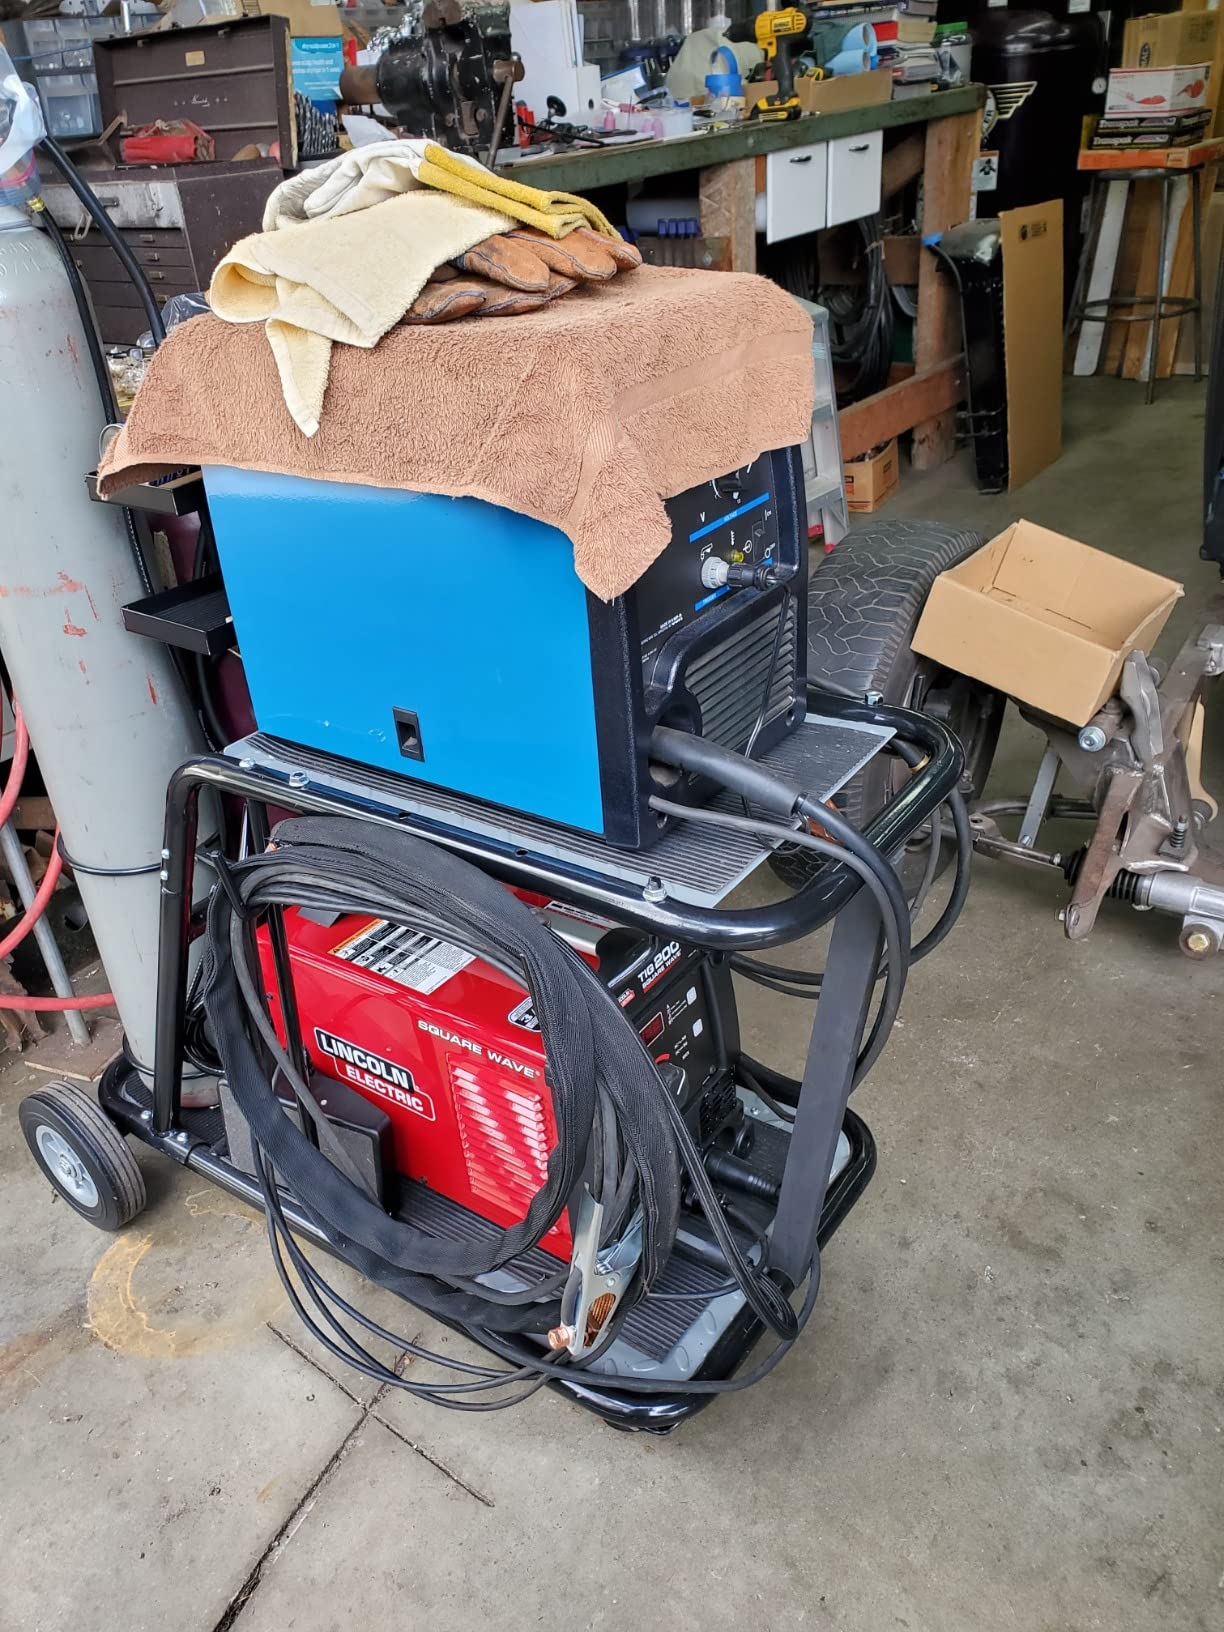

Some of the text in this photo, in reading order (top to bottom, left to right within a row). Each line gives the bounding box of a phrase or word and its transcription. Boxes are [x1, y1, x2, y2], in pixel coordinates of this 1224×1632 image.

[637, 941, 680, 983] TIG 200
[642, 948, 682, 989] SQUARE WAVE
[417, 1020, 482, 1055] SQUARE
[320, 1033, 409, 1090] LINCOLN
[345, 1064, 424, 1112] ELECTRIC
